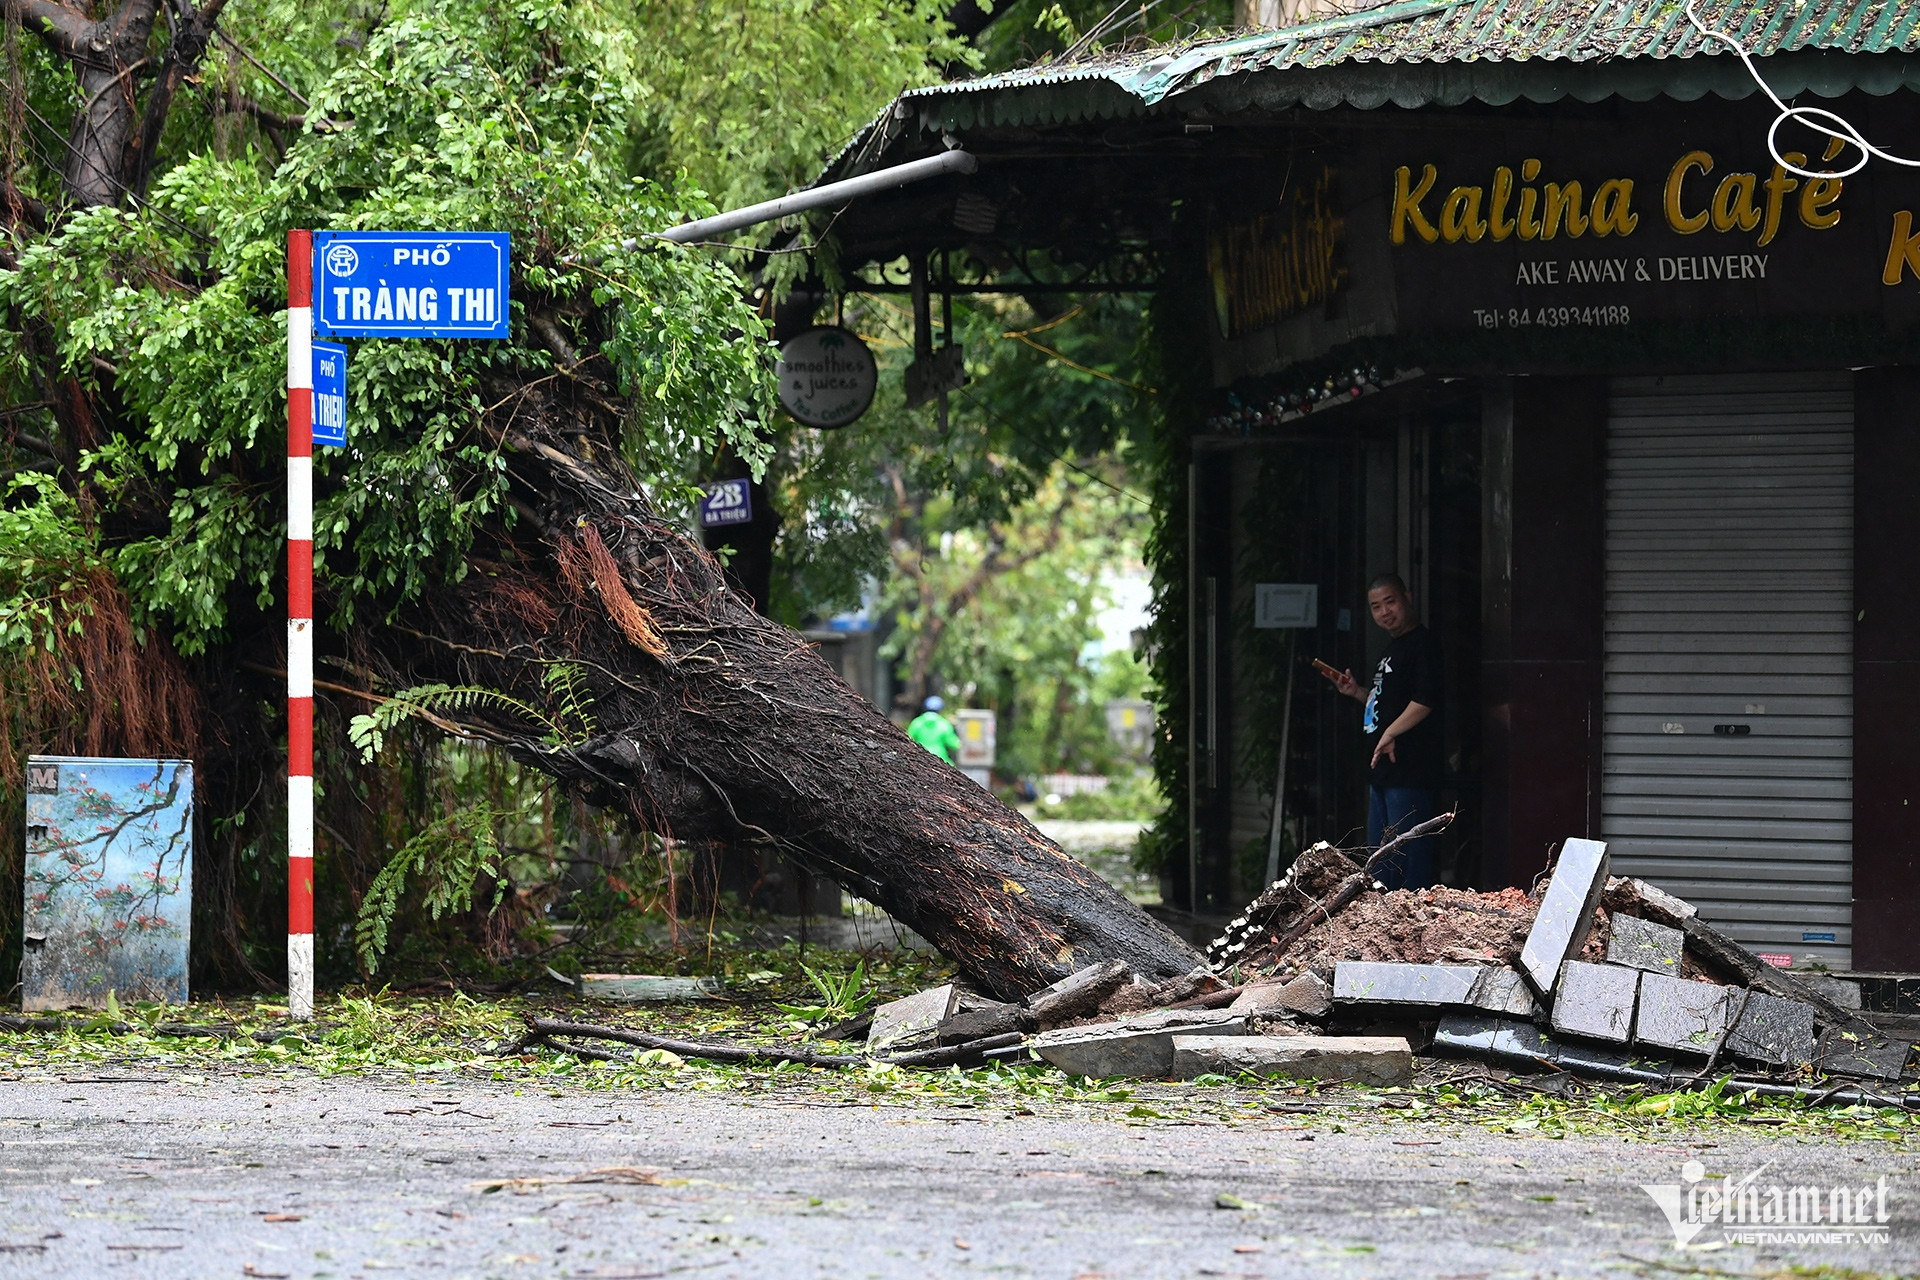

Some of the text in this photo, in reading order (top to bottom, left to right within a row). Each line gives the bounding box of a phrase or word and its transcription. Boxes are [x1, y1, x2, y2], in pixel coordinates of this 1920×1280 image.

[1389, 136, 1845, 247] Kalina Café
[393, 242, 452, 266] PHỐ
[1515, 254, 1769, 285] AKE AWAY & DELIVERY
[333, 278, 495, 321] TRÀNG THI
[1508, 308, 1531, 328] 84
[320, 355, 336, 378] PHỐ
[785, 350, 865, 374] smoothies
[804, 376, 858, 400] juices
[318, 387, 343, 435] TRIỆU
[793, 397, 811, 417] Tea
[821, 399, 858, 421] Coffee
[707, 483, 744, 510] 2B
[30, 768, 56, 790] M
